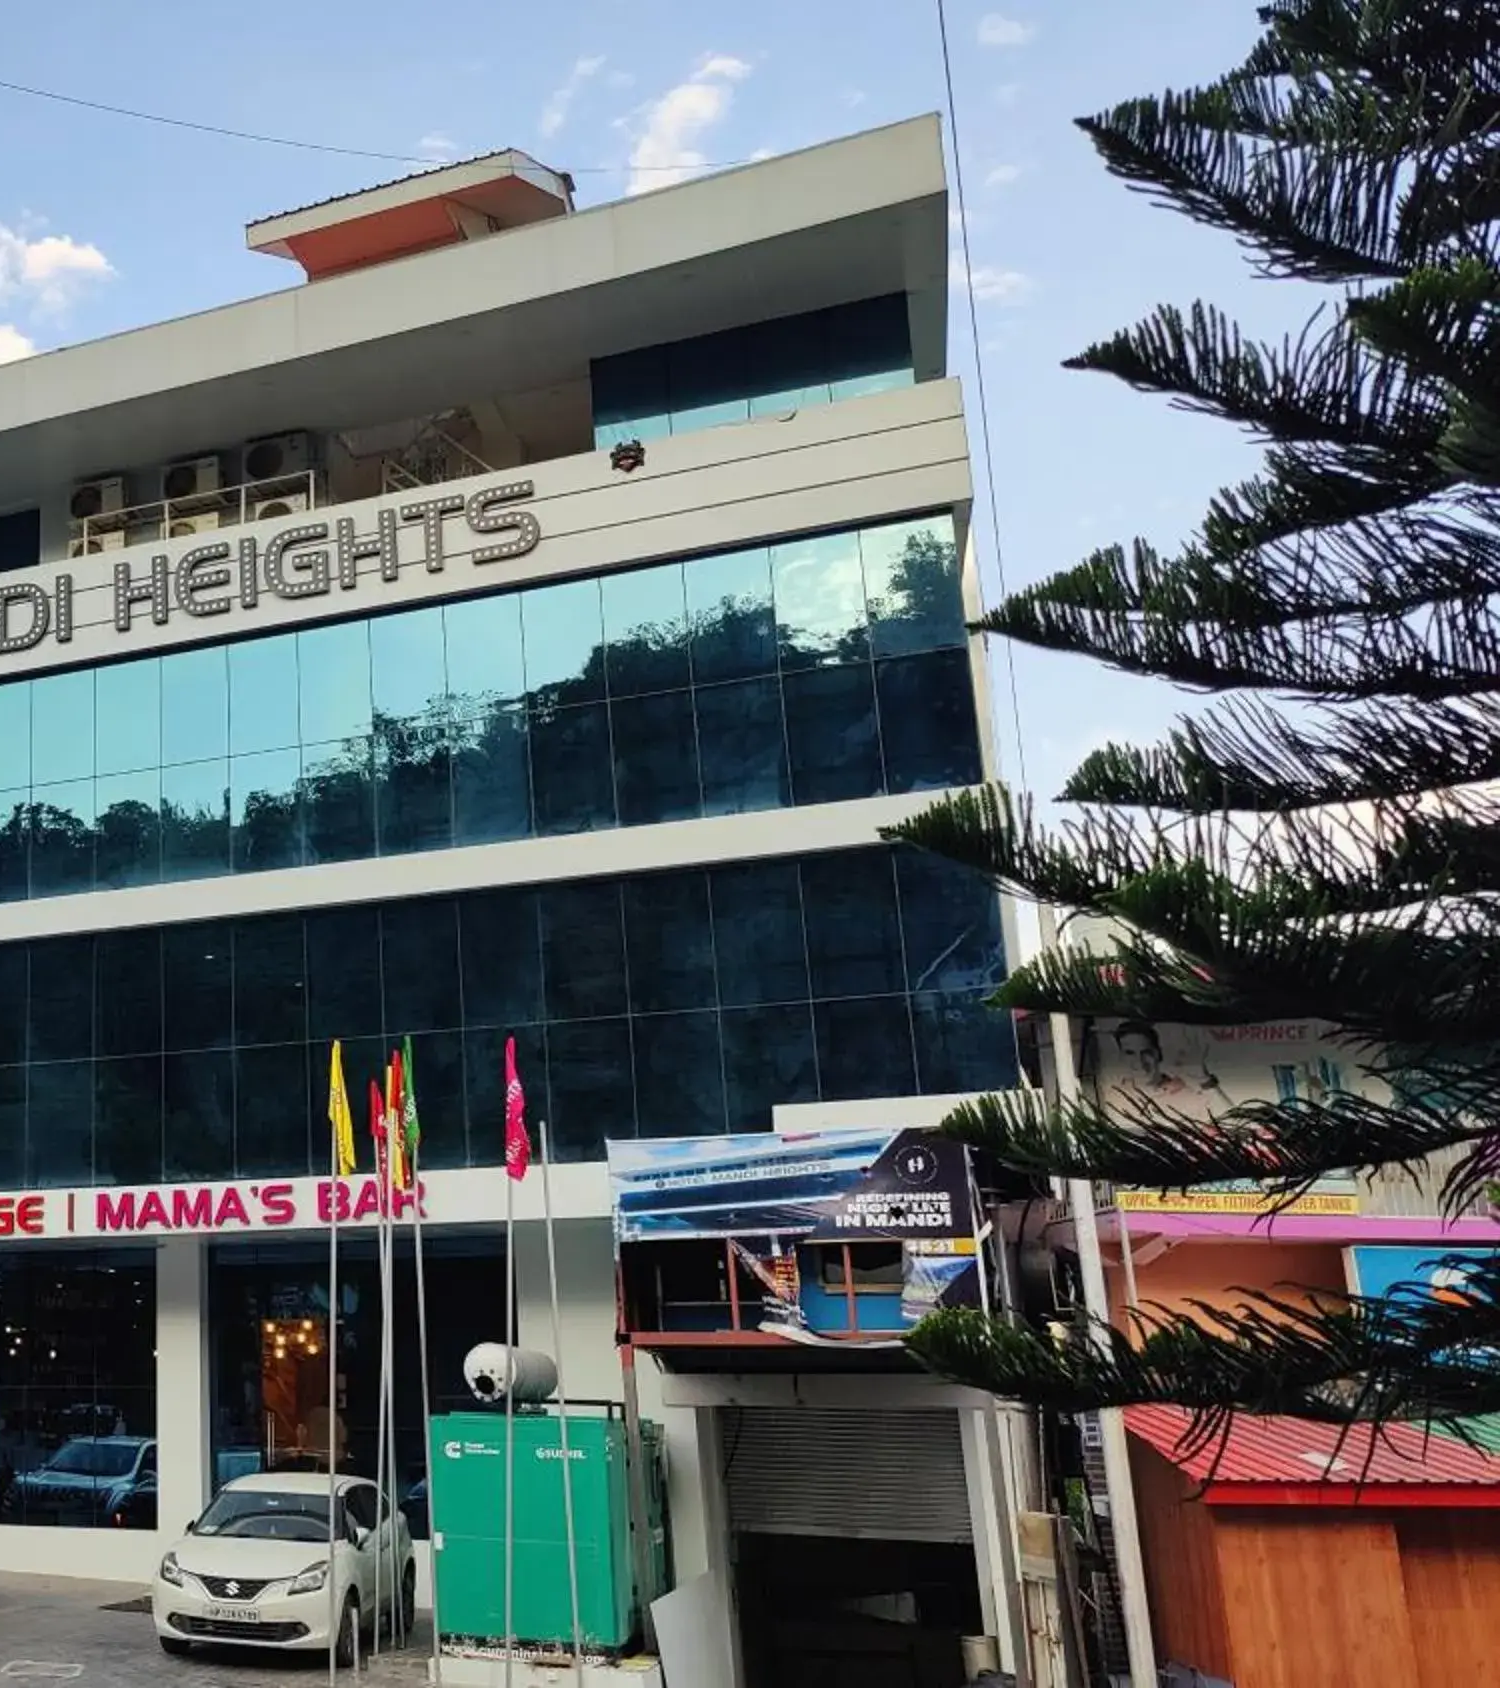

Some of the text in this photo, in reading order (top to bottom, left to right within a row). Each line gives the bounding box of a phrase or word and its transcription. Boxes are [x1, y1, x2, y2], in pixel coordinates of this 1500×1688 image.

[114, 479, 541, 632] HEIGHTS
[1238, 1024, 1309, 1041] PRINCE
[667, 1161, 832, 1188] HOTEL MANDI HEIGHTS
[96, 1183, 297, 1232] MAMA'S
[317, 1179, 428, 1222] BAR
[855, 1191, 951, 1203] REDEFINING
[835, 1213, 953, 1228] IN MANDI
